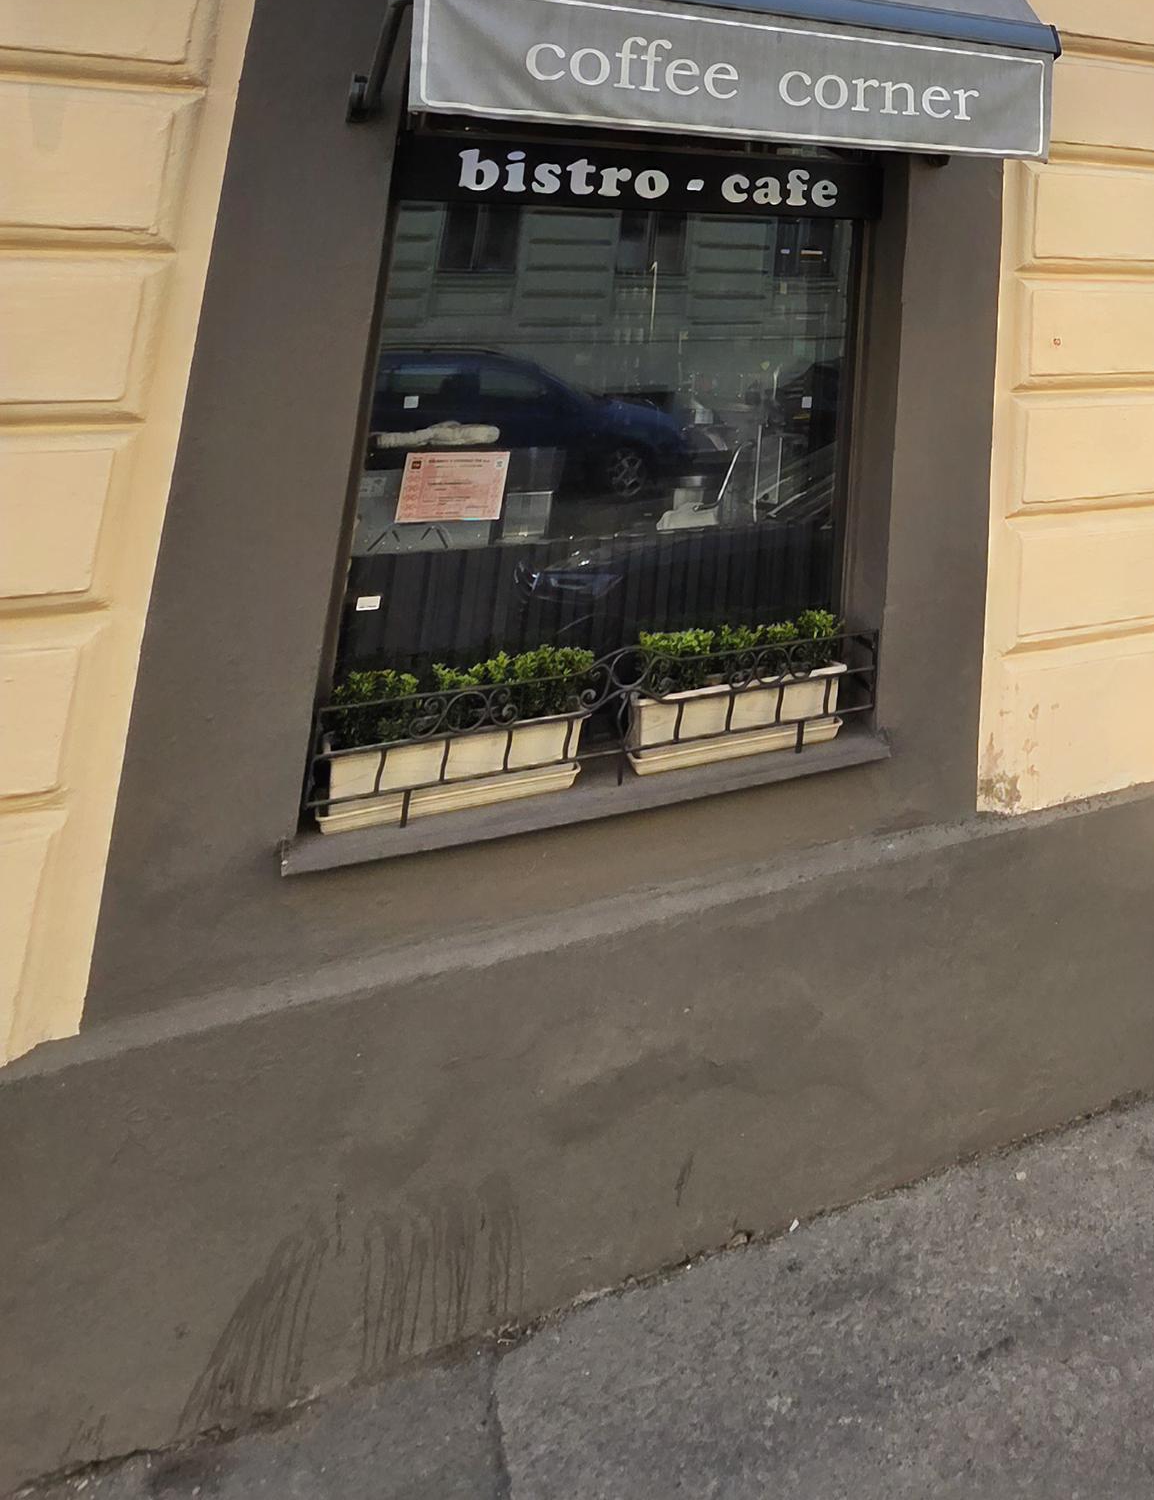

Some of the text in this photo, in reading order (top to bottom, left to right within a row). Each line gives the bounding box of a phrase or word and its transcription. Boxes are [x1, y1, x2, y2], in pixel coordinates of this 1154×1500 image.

[525, 36, 980, 121] coffee corner
[458, 149, 669, 199] bistro
[721, 169, 839, 208] cafe
